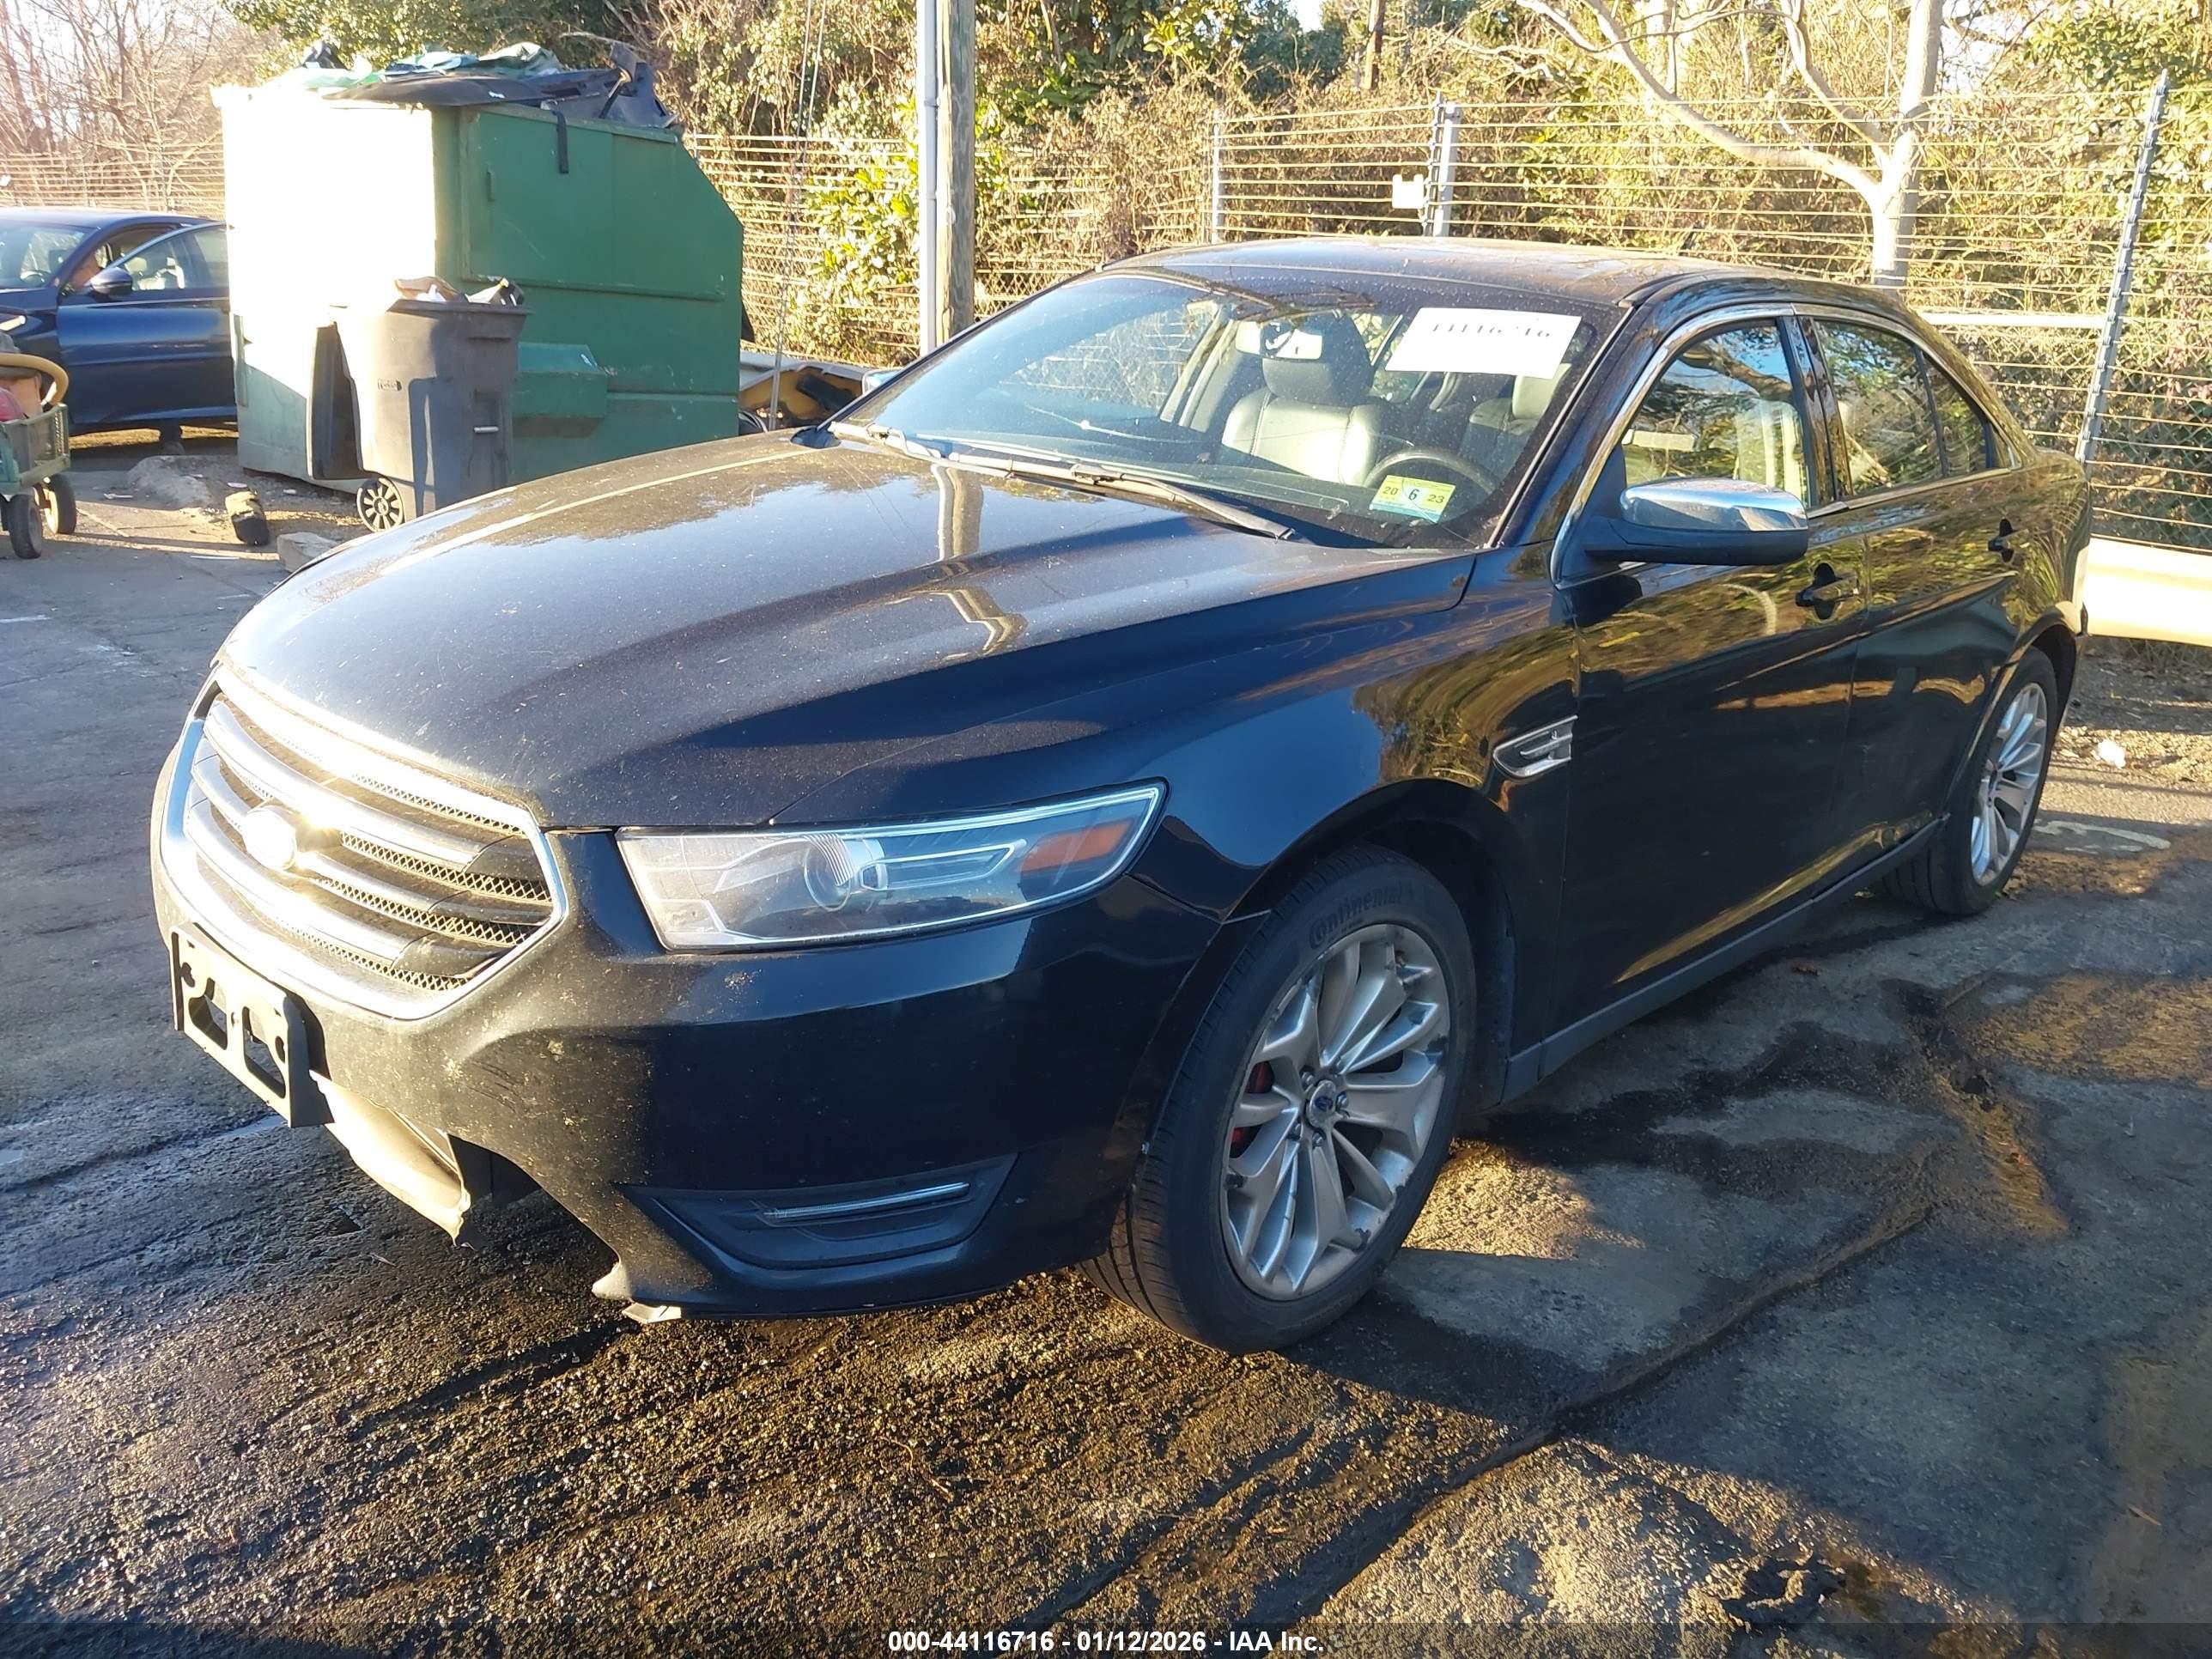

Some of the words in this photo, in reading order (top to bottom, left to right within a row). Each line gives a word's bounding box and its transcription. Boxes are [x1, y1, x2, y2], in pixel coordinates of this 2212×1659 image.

[1382, 486, 1400, 496] 20
[1407, 488, 1420, 501] 6
[1427, 494, 1445, 504] 23
